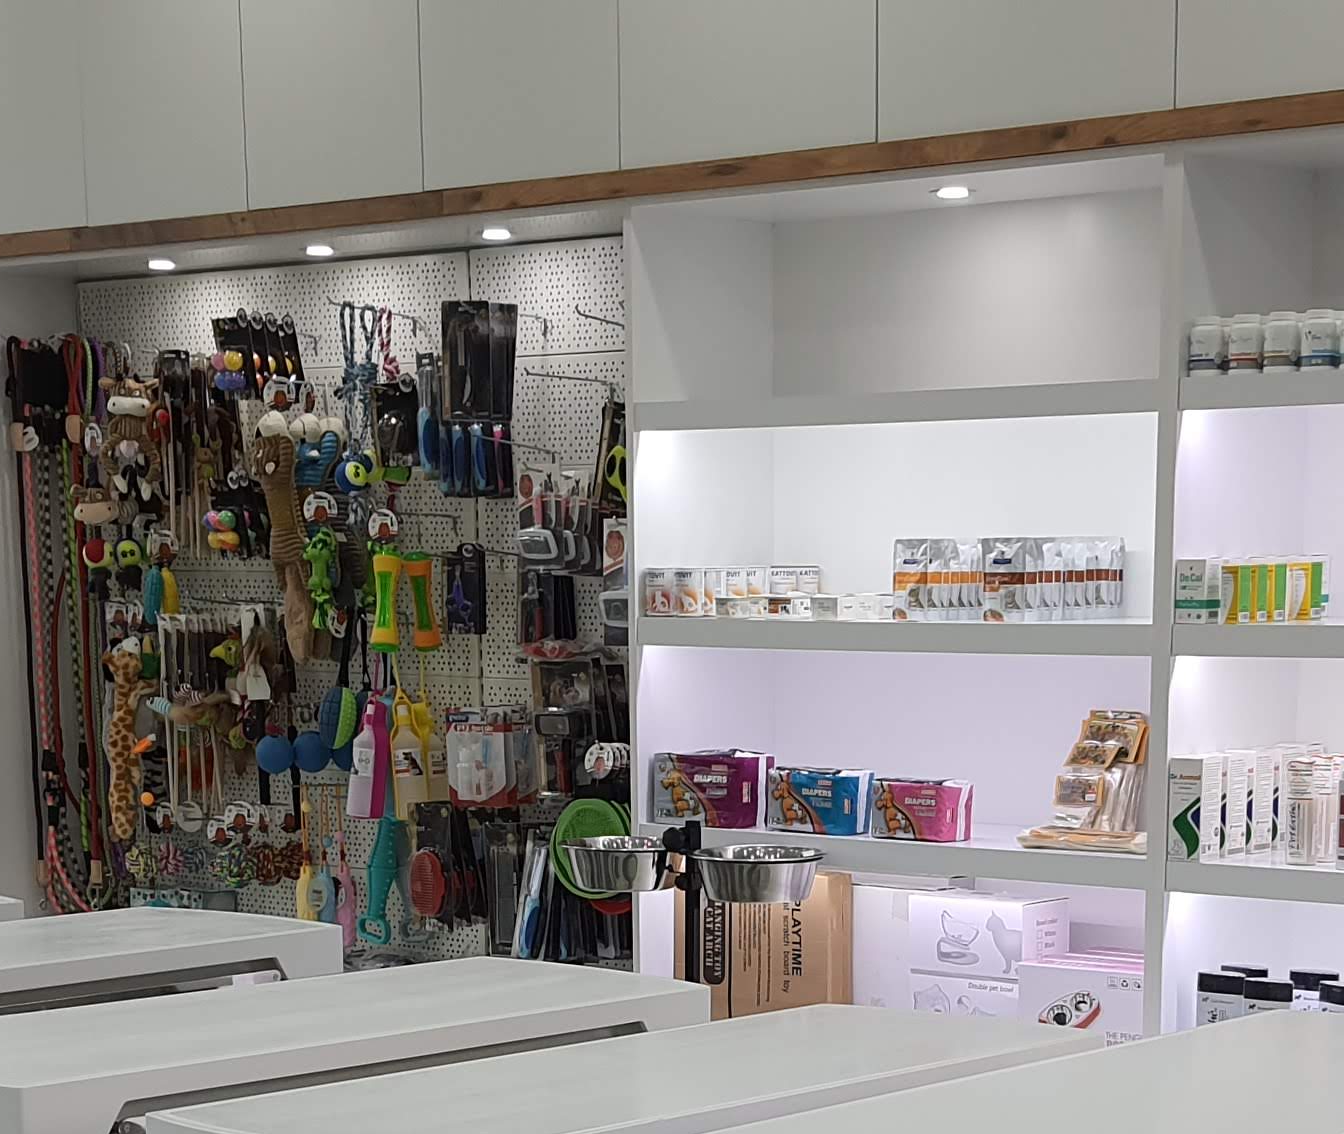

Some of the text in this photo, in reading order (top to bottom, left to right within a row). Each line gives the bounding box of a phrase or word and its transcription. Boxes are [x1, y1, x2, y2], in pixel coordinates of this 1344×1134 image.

[693, 774, 728, 784] DIAPERS
[801, 787, 832, 798] DIAPERS
[904, 796, 936, 806] DIAPERS
[791, 900, 803, 977] PLAYTIME
